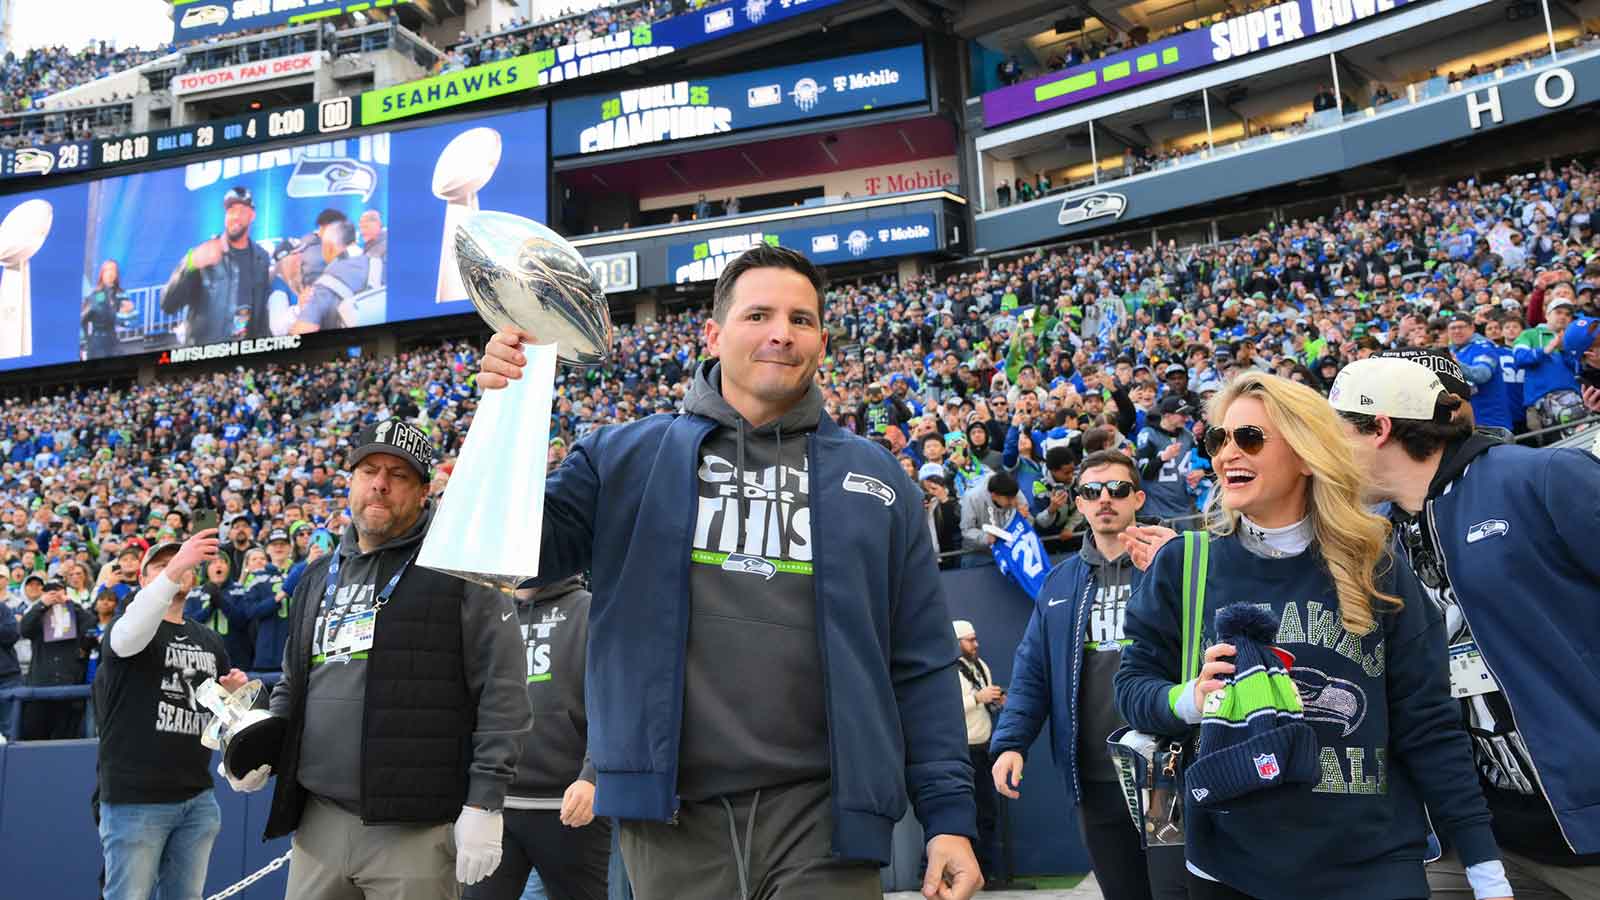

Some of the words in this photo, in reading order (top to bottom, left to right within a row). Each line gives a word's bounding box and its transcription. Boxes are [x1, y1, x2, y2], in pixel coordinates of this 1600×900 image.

[1210, 1, 1304, 61] SUPER
[180, 72, 233, 89] TOYOTA
[240, 66, 267, 84] FAN
[273, 56, 312, 73] DECK
[849, 68, 899, 90] Mobile
[382, 66, 518, 113] SEAHAWKS
[620, 81, 689, 114] WORLD
[690, 86, 709, 105] 25
[246, 118, 257, 138] 4
[268, 108, 304, 136] 0:00
[580, 106, 732, 154] CHAMPIONS
[58, 145, 79, 169] 29
[886, 170, 953, 193] Mobile
[891, 225, 929, 241] Mobile
[171, 341, 239, 363] MITSUBISHI
[240, 334, 301, 354] ELECTRIC
[698, 455, 809, 495] CUT
[718, 484, 796, 503] FOR
[692, 496, 813, 562] THIS
